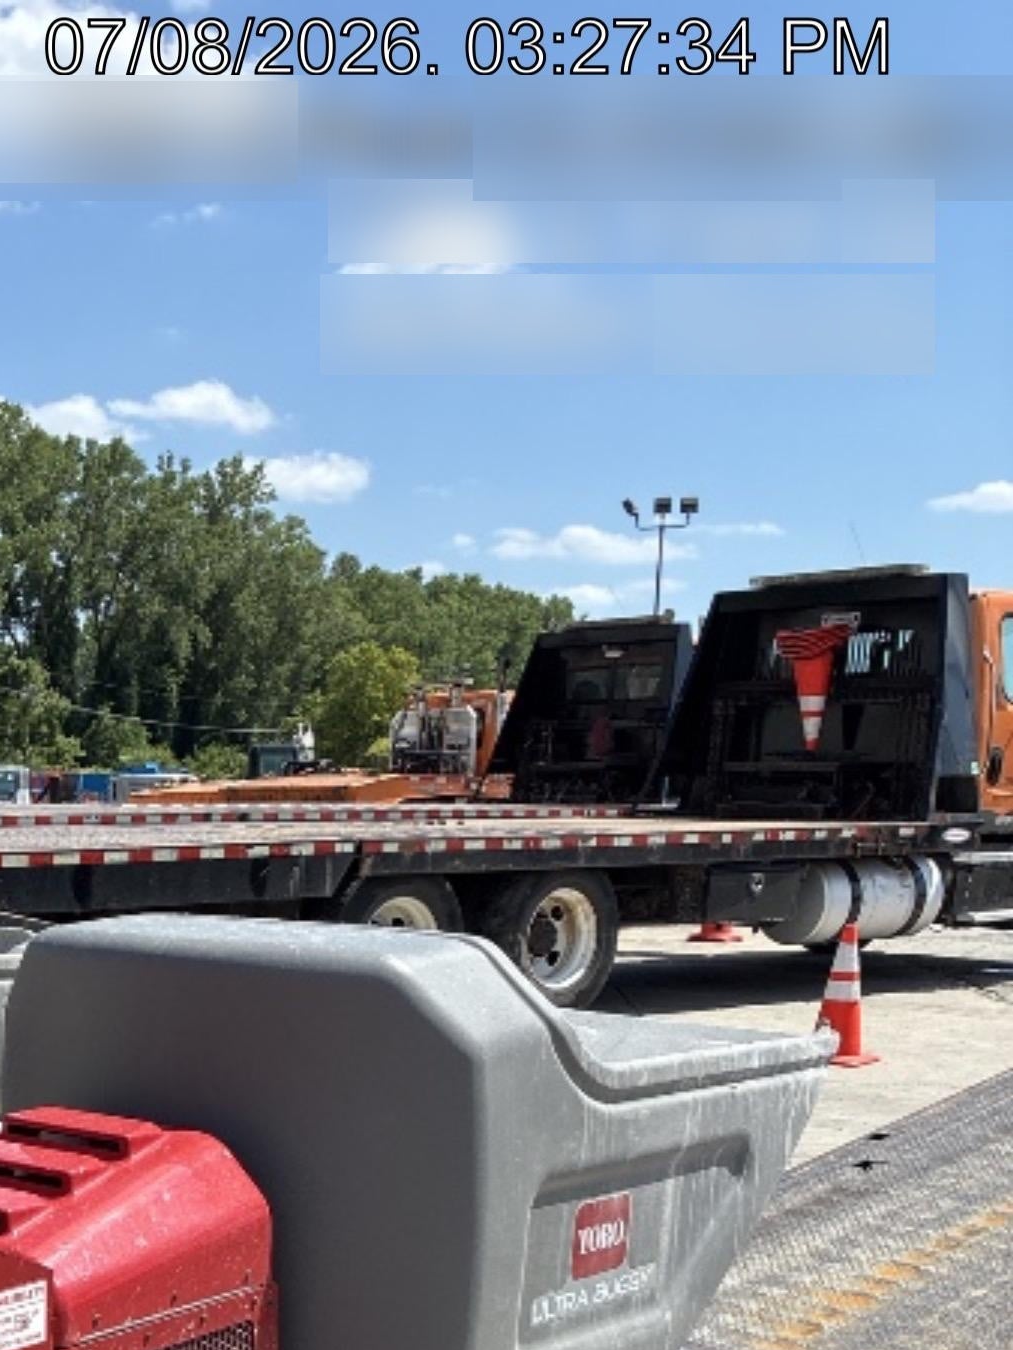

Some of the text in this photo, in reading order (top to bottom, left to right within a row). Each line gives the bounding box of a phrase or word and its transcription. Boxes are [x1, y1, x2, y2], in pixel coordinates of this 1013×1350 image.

[578, 1217, 625, 1255] TORO
[530, 1262, 656, 1327] ULTRA BUGGY
